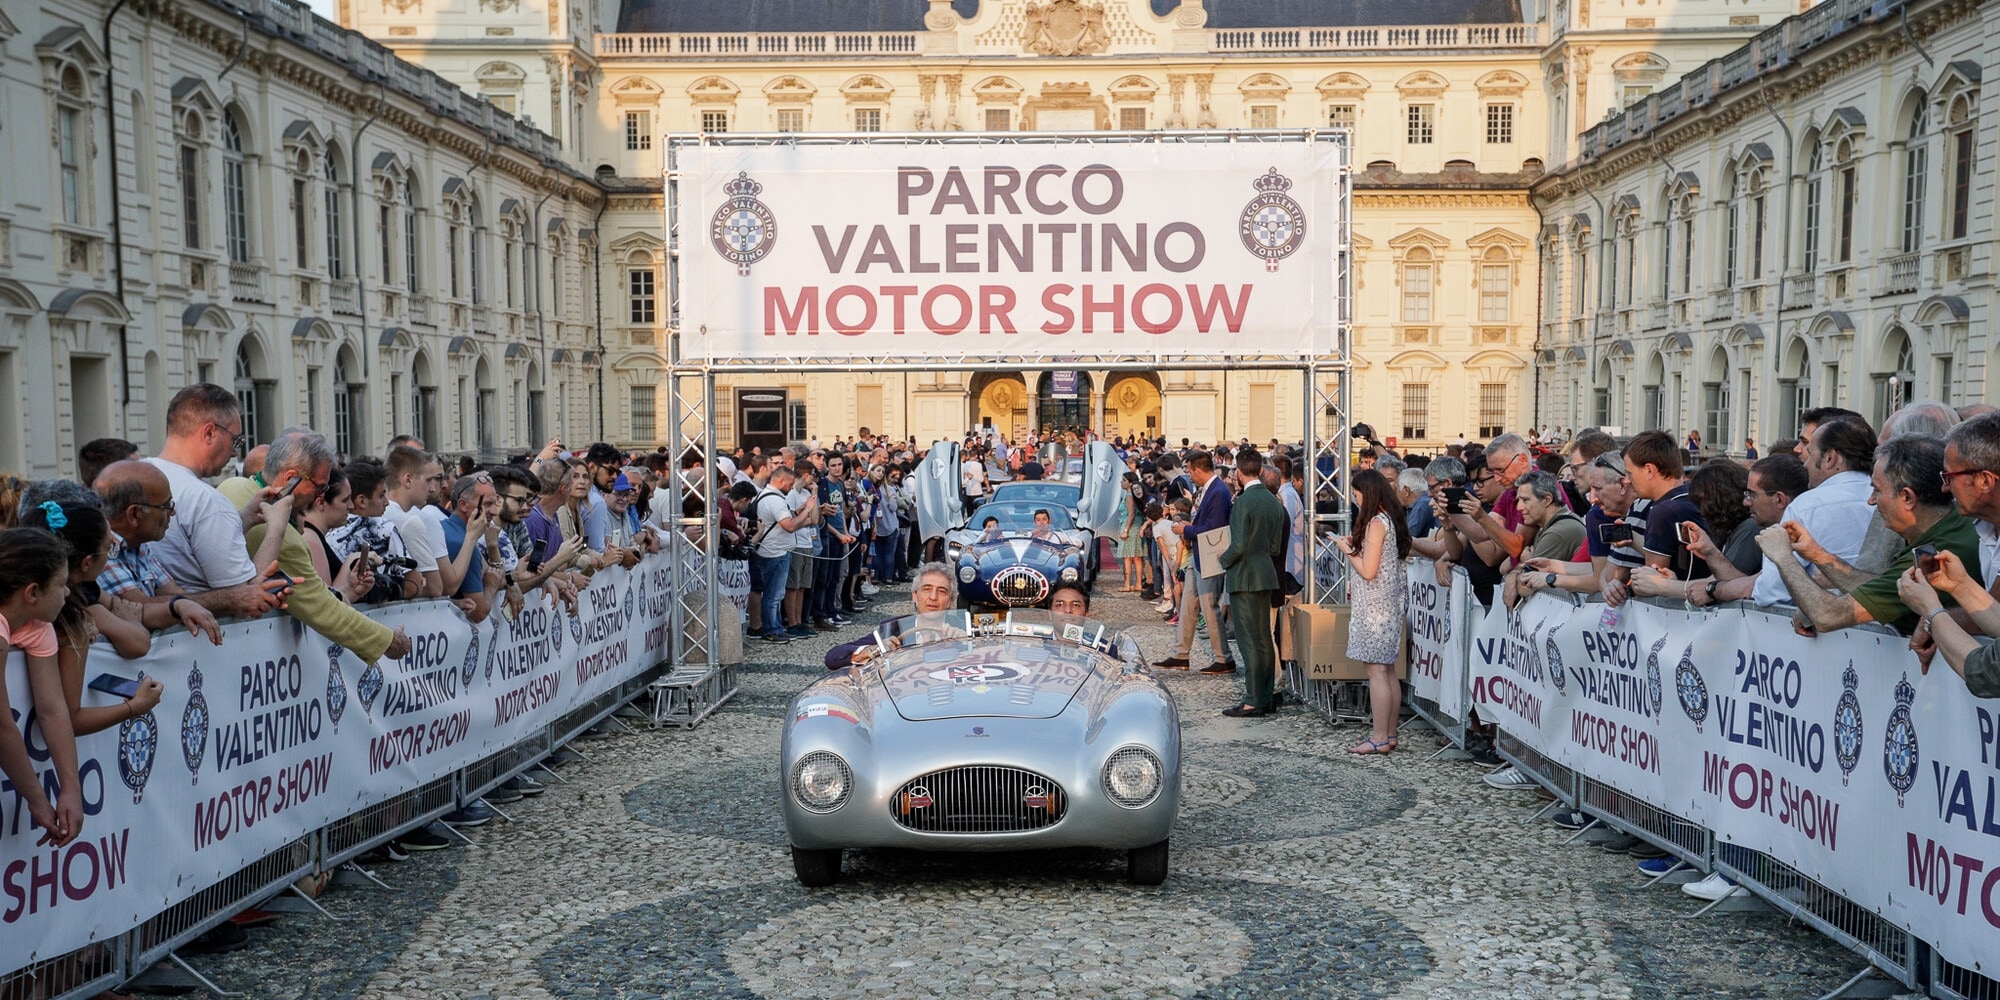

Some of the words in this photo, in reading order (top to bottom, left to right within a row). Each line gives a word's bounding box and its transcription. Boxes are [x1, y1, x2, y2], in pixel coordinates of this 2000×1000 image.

[897, 163, 1124, 216] PARCO
[713, 206, 731, 239] PARCO
[732, 200, 774, 239] VALENTINO
[1243, 203, 1259, 235] PARCO
[1262, 196, 1303, 235] VALENTINO
[724, 248, 764, 262] TORINO
[811, 221, 1206, 275] VALENTINO
[1252, 244, 1292, 258] TORINO
[763, 284, 1017, 336] MOTOR
[1040, 283, 1254, 335] SHOW
[509, 606, 547, 643] PARCO
[398, 631, 448, 673] ARCO
[605, 638, 628, 672] SHOW
[1313, 664, 1333, 674] A11
[1582, 630, 1638, 671] PARCO
[240, 654, 302, 712] PARCO
[383, 666, 457, 717] VALENTINO
[529, 670, 561, 710] SHOW
[215, 698, 322, 773] VALENTINO
[369, 723, 426, 776] MOTOR
[425, 708, 471, 755] SHOW
[1572, 708, 1616, 759] MOTOR
[1715, 694, 1825, 774] VLENTINO
[194, 775, 272, 852] MOTOR
[272, 751, 333, 814] SHOW
[1779, 776, 1840, 852] SHOW
[3, 827, 130, 924] SHOW
